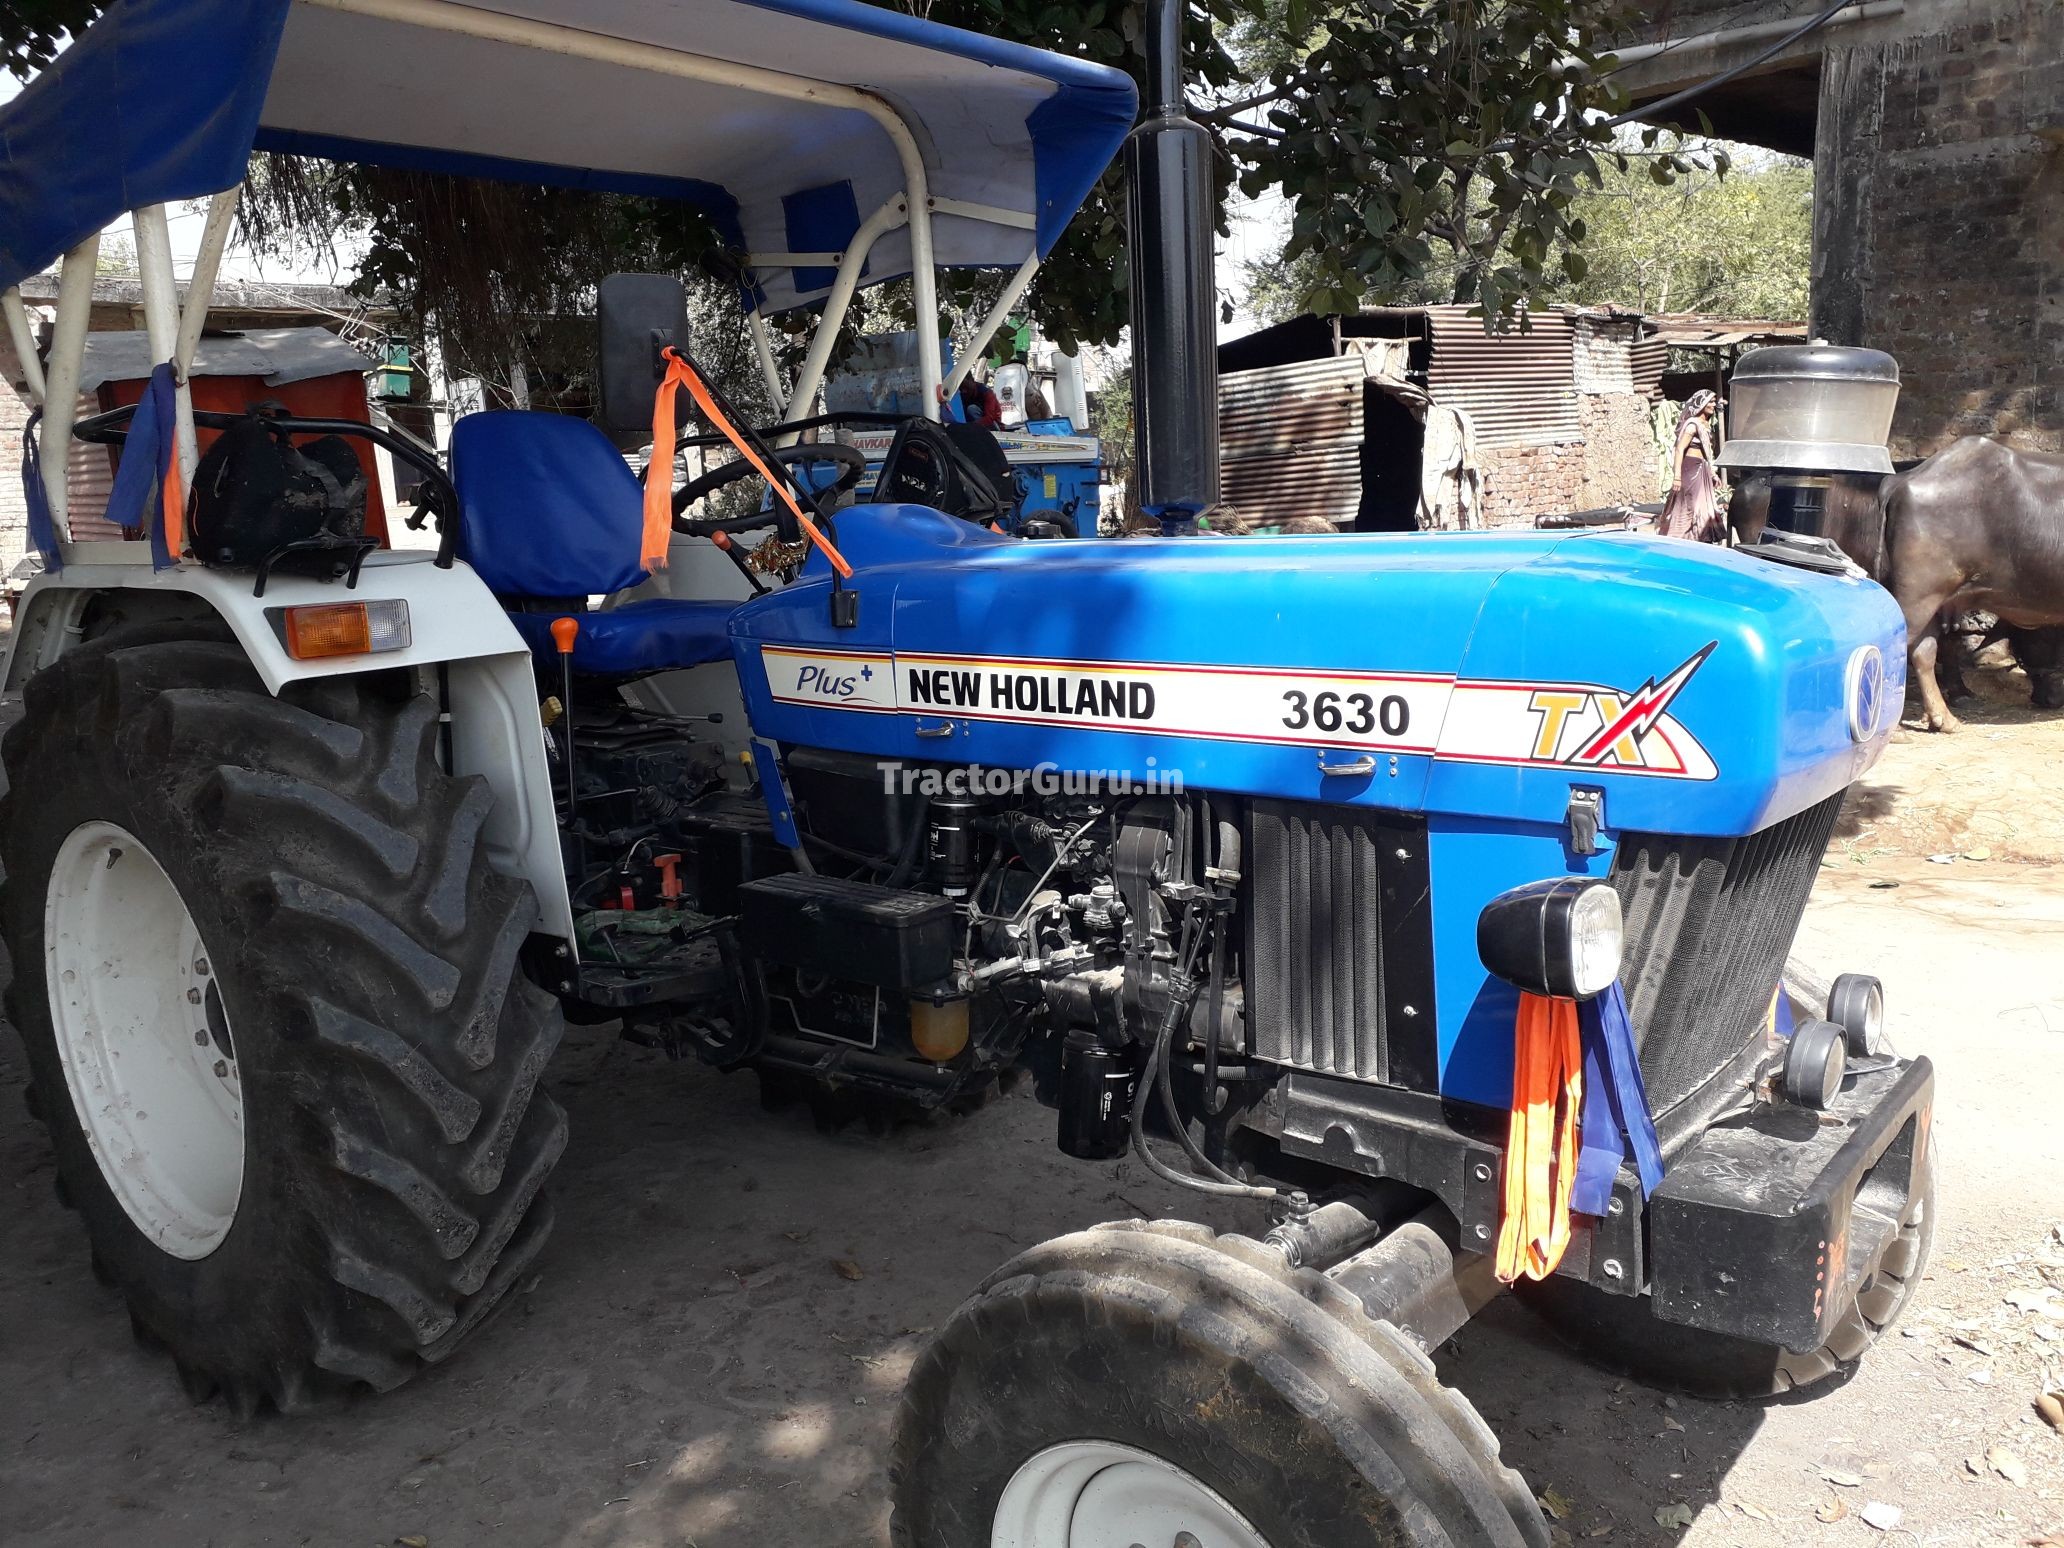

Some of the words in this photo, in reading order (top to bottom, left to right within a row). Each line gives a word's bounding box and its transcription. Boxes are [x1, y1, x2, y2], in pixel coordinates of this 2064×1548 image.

[908, 668, 982, 707] NEW
[989, 673, 1156, 720] HOLLAND
[1281, 689, 1410, 736] 3630
